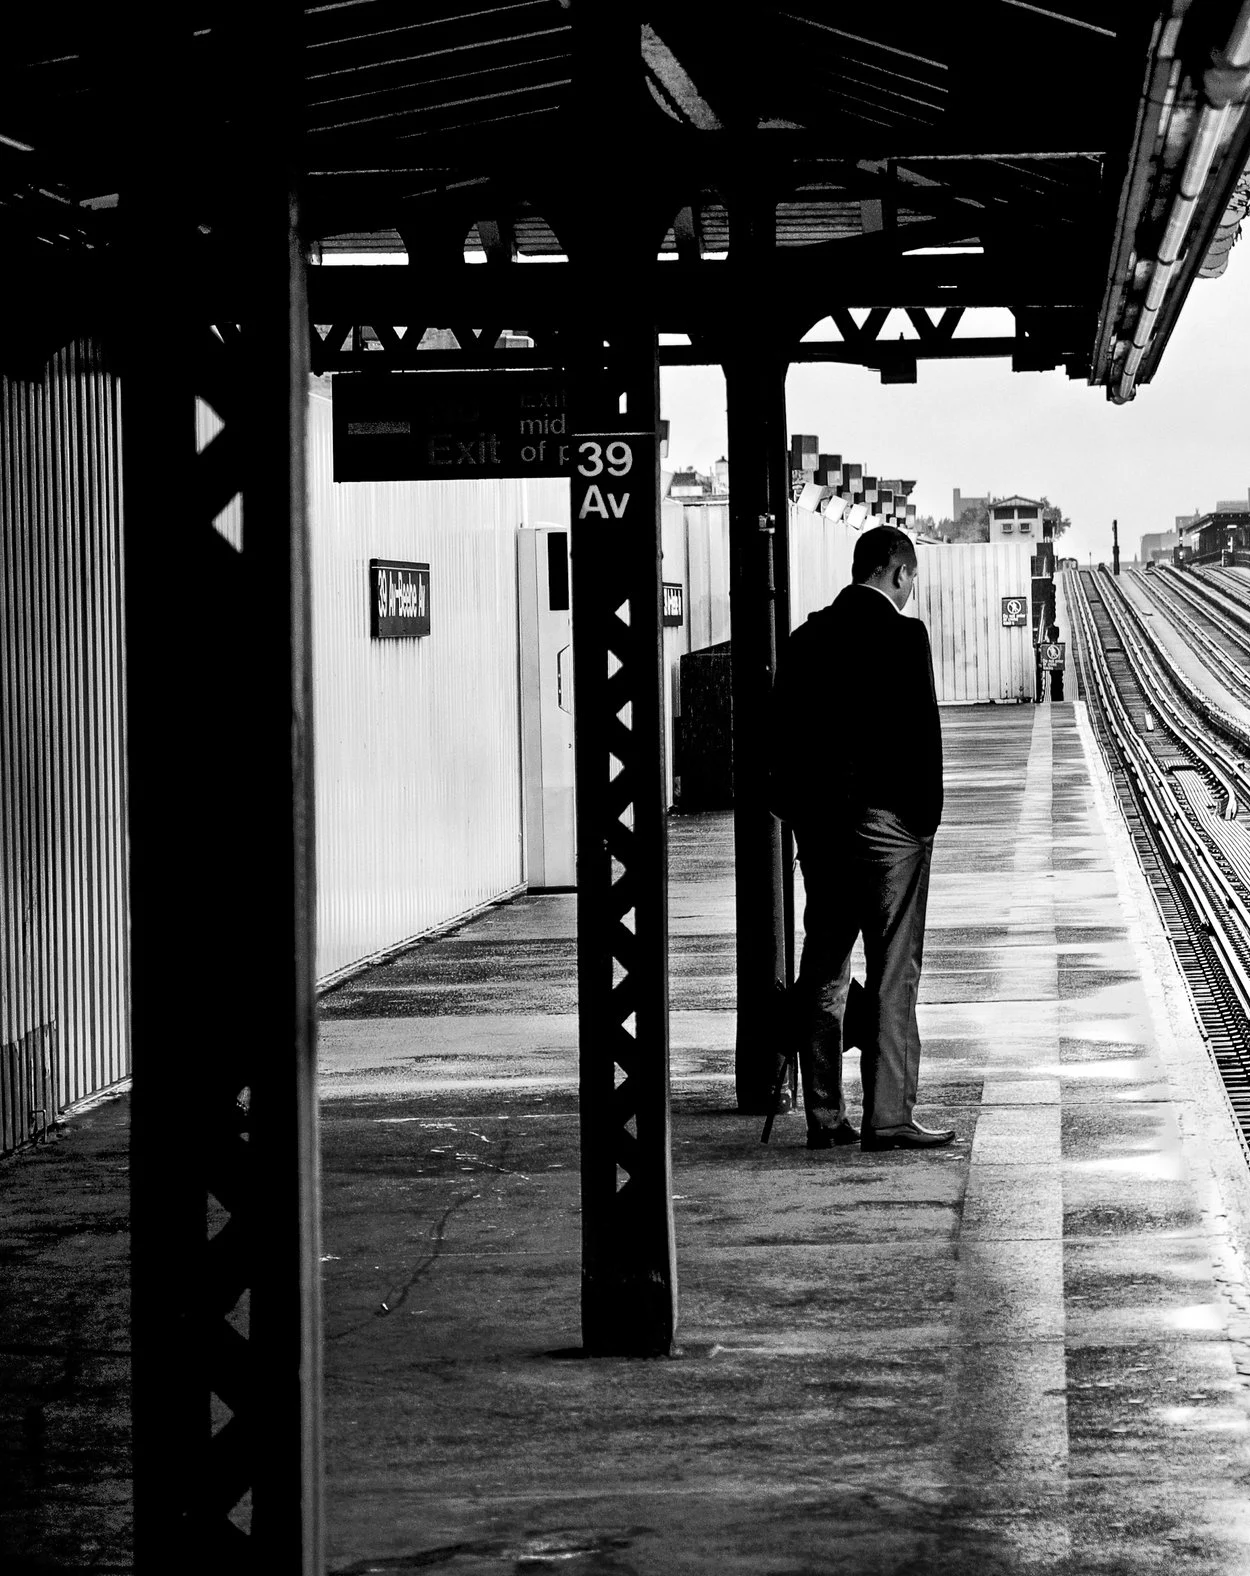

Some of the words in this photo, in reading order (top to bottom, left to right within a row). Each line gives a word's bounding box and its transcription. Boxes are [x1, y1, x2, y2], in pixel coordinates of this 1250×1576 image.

[427, 432, 501, 465] Exit
[520, 440, 547, 462] of
[577, 441, 633, 477] 39
[578, 484, 631, 519] Av
[378, 569, 388, 618] 39
